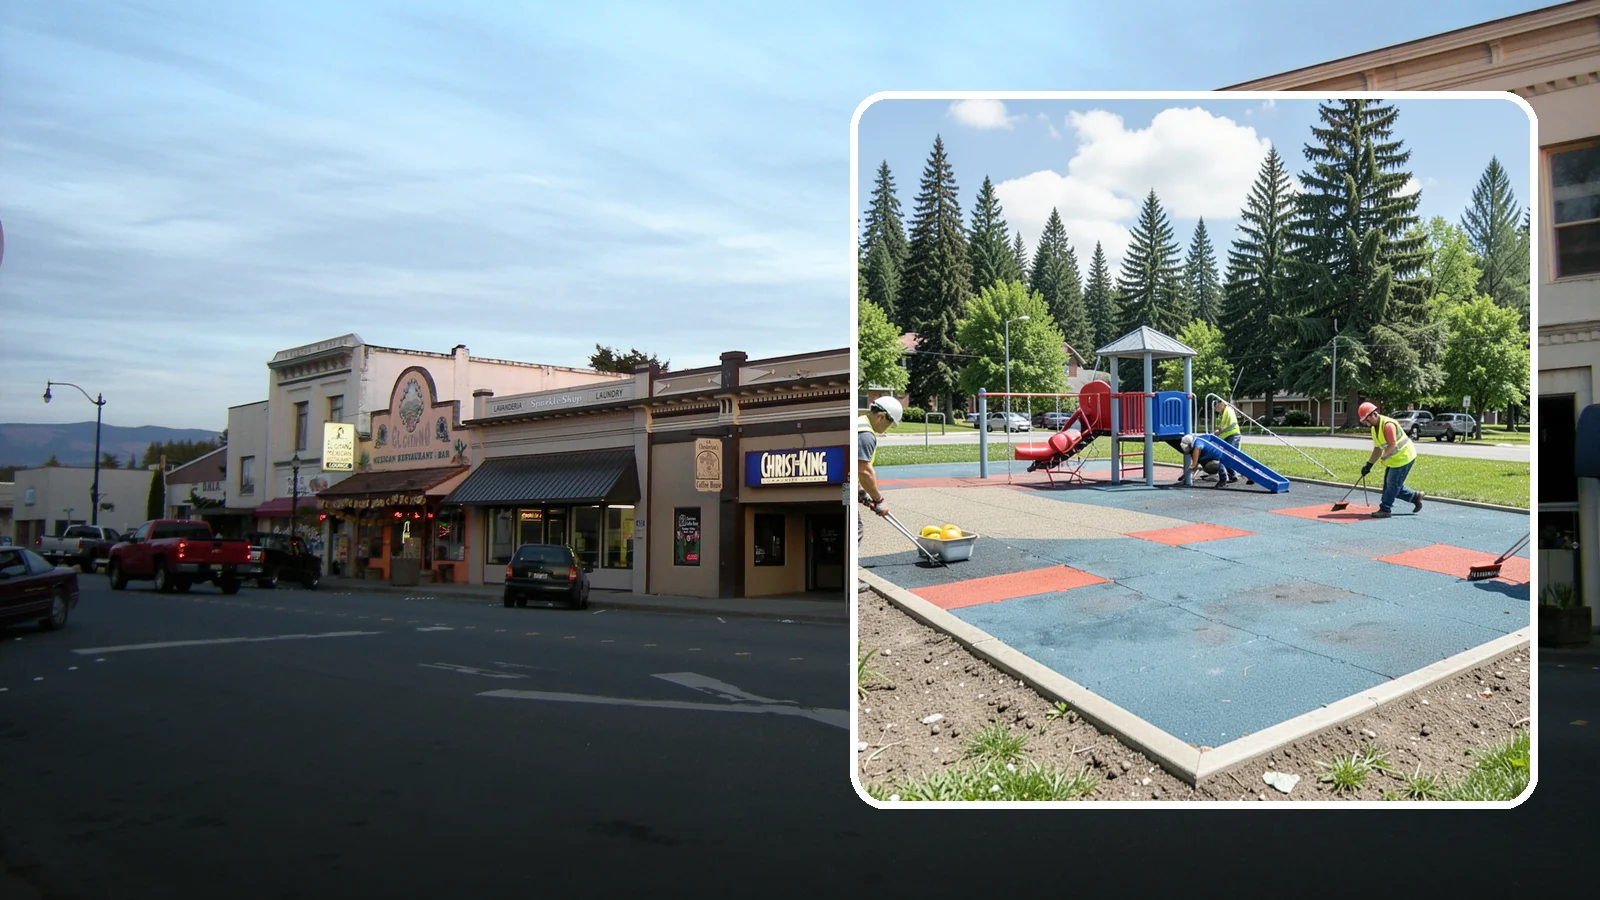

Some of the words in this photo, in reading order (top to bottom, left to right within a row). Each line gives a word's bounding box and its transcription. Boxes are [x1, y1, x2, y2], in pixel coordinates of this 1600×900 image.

[596, 389, 623, 400] LAUNDRY
[494, 402, 523, 412] LAVANDERIA
[531, 397, 561, 409] Sparkle
[561, 395, 582, 404] Shop
[373, 455, 396, 464] MEXICAN
[397, 452, 433, 462] RESTAURANT
[438, 450, 450, 459] BAR
[761, 452, 797, 478] CHRIST
[799, 450, 827, 476] KING
[696, 480, 709, 489] Coffee
